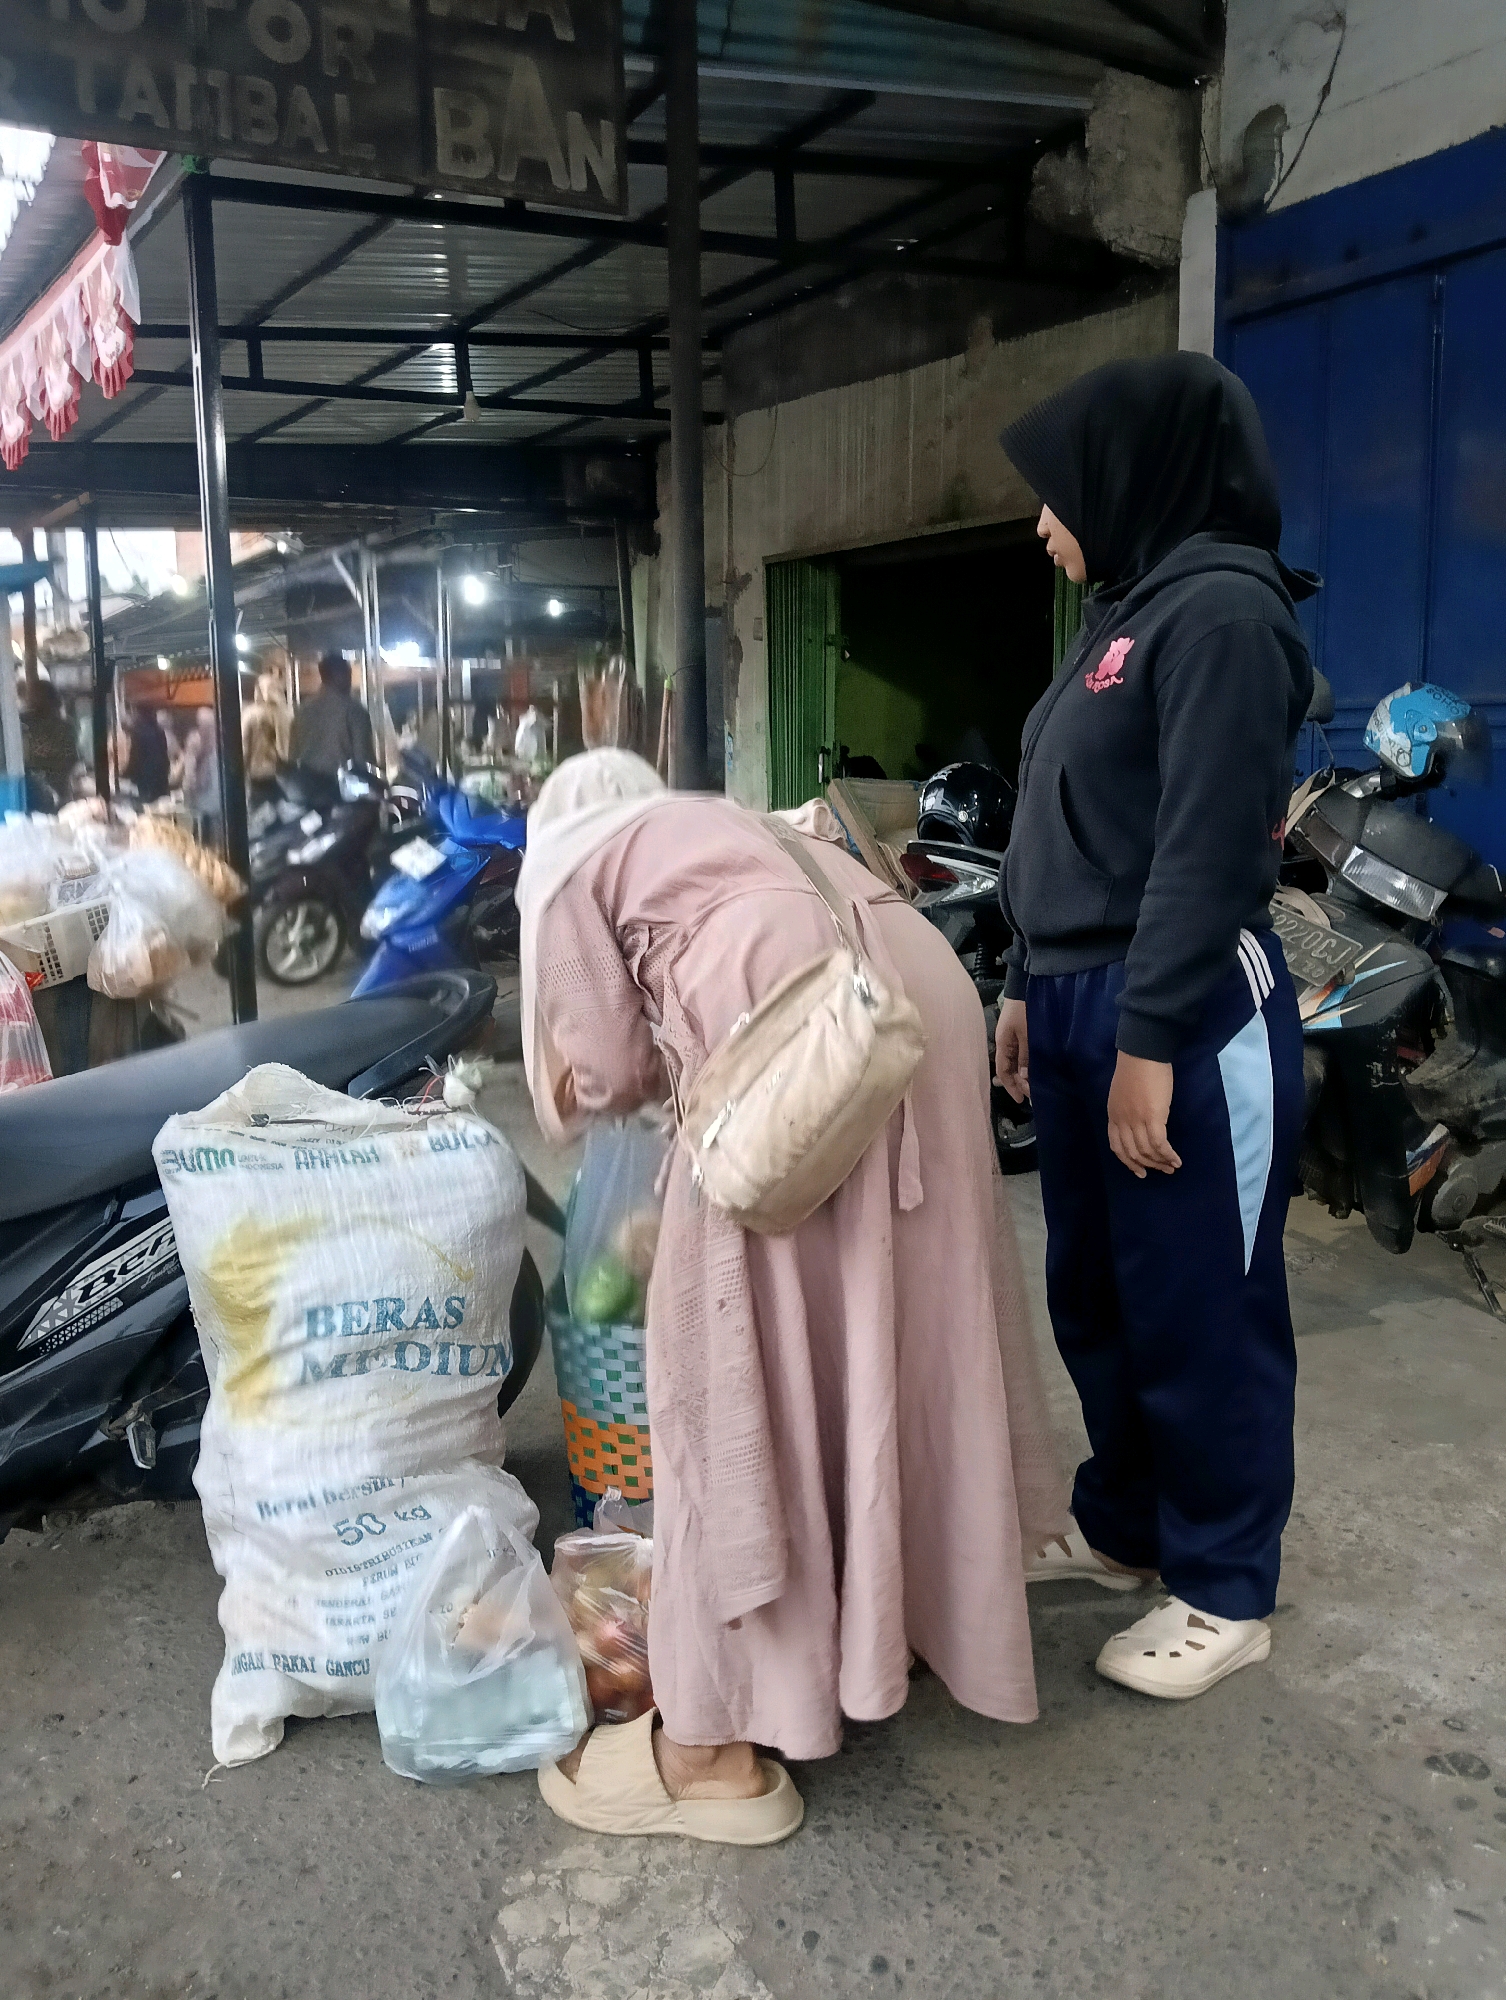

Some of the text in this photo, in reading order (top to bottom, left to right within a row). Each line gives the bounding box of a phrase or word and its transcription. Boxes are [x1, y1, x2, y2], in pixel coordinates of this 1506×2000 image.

[433, 54, 618, 204] BAN
[304, 1296, 466, 1339] BERAS
[332, 1512, 387, 1547] 50
[271, 1653, 318, 1674] PAKAI
[325, 1657, 371, 1678] GANCU
